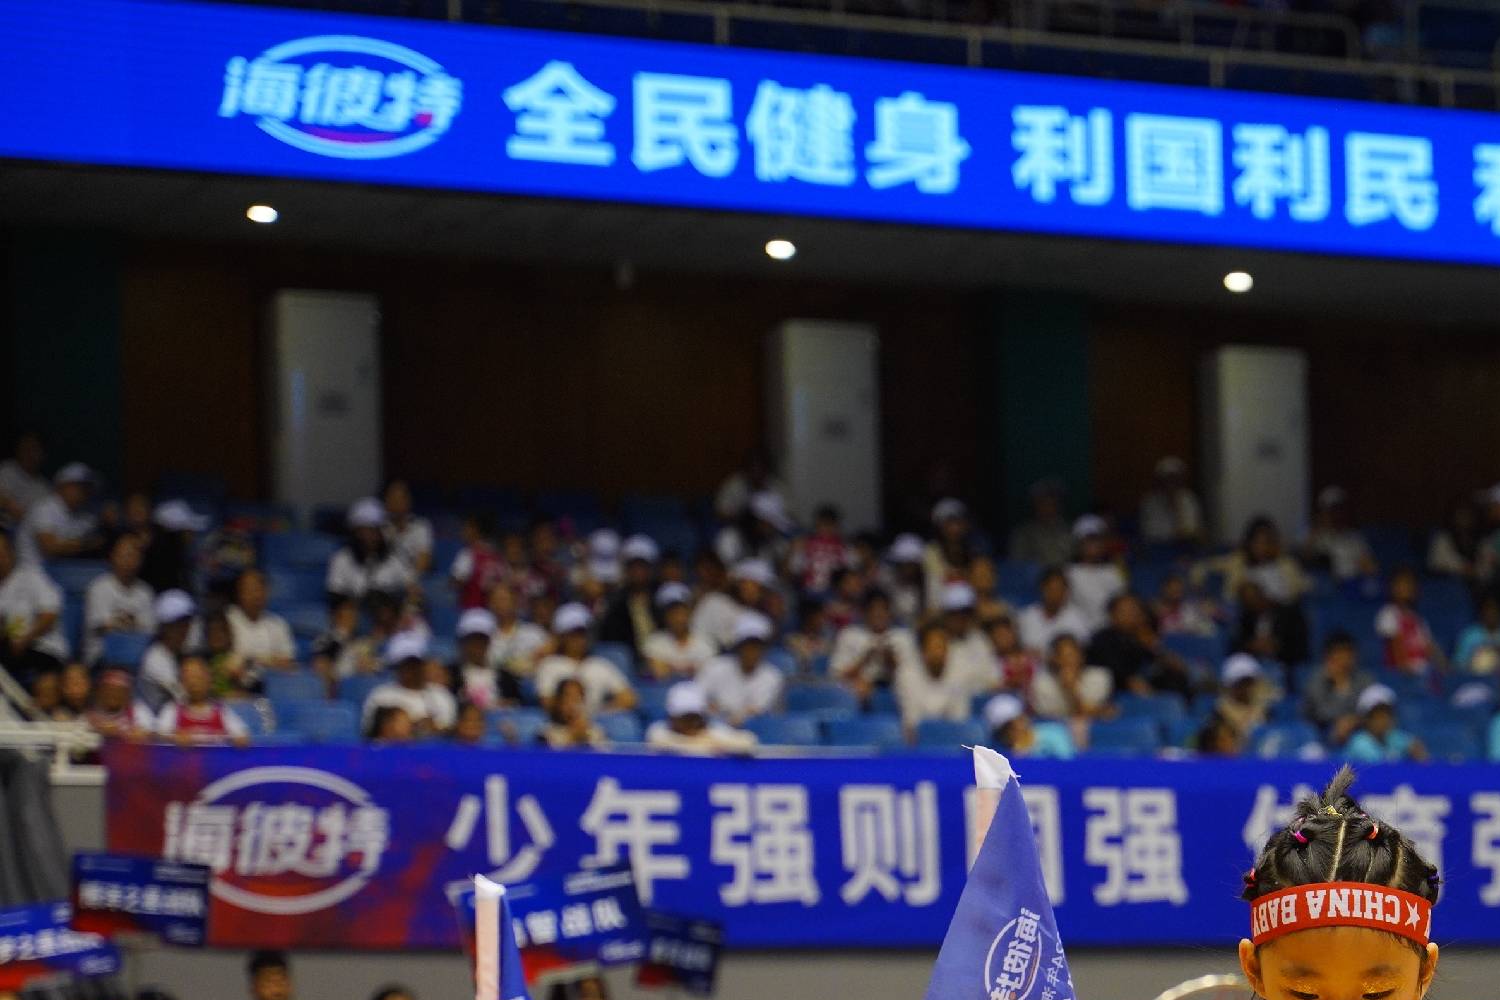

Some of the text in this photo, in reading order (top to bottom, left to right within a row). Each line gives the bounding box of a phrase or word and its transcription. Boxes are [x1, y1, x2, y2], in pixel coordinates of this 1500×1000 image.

[217, 55, 463, 137] 海彼特
[504, 59, 970, 195] 全民健身
[1011, 103, 1440, 231] 利国利民
[1253, 888, 1401, 937] CHINA BABY
